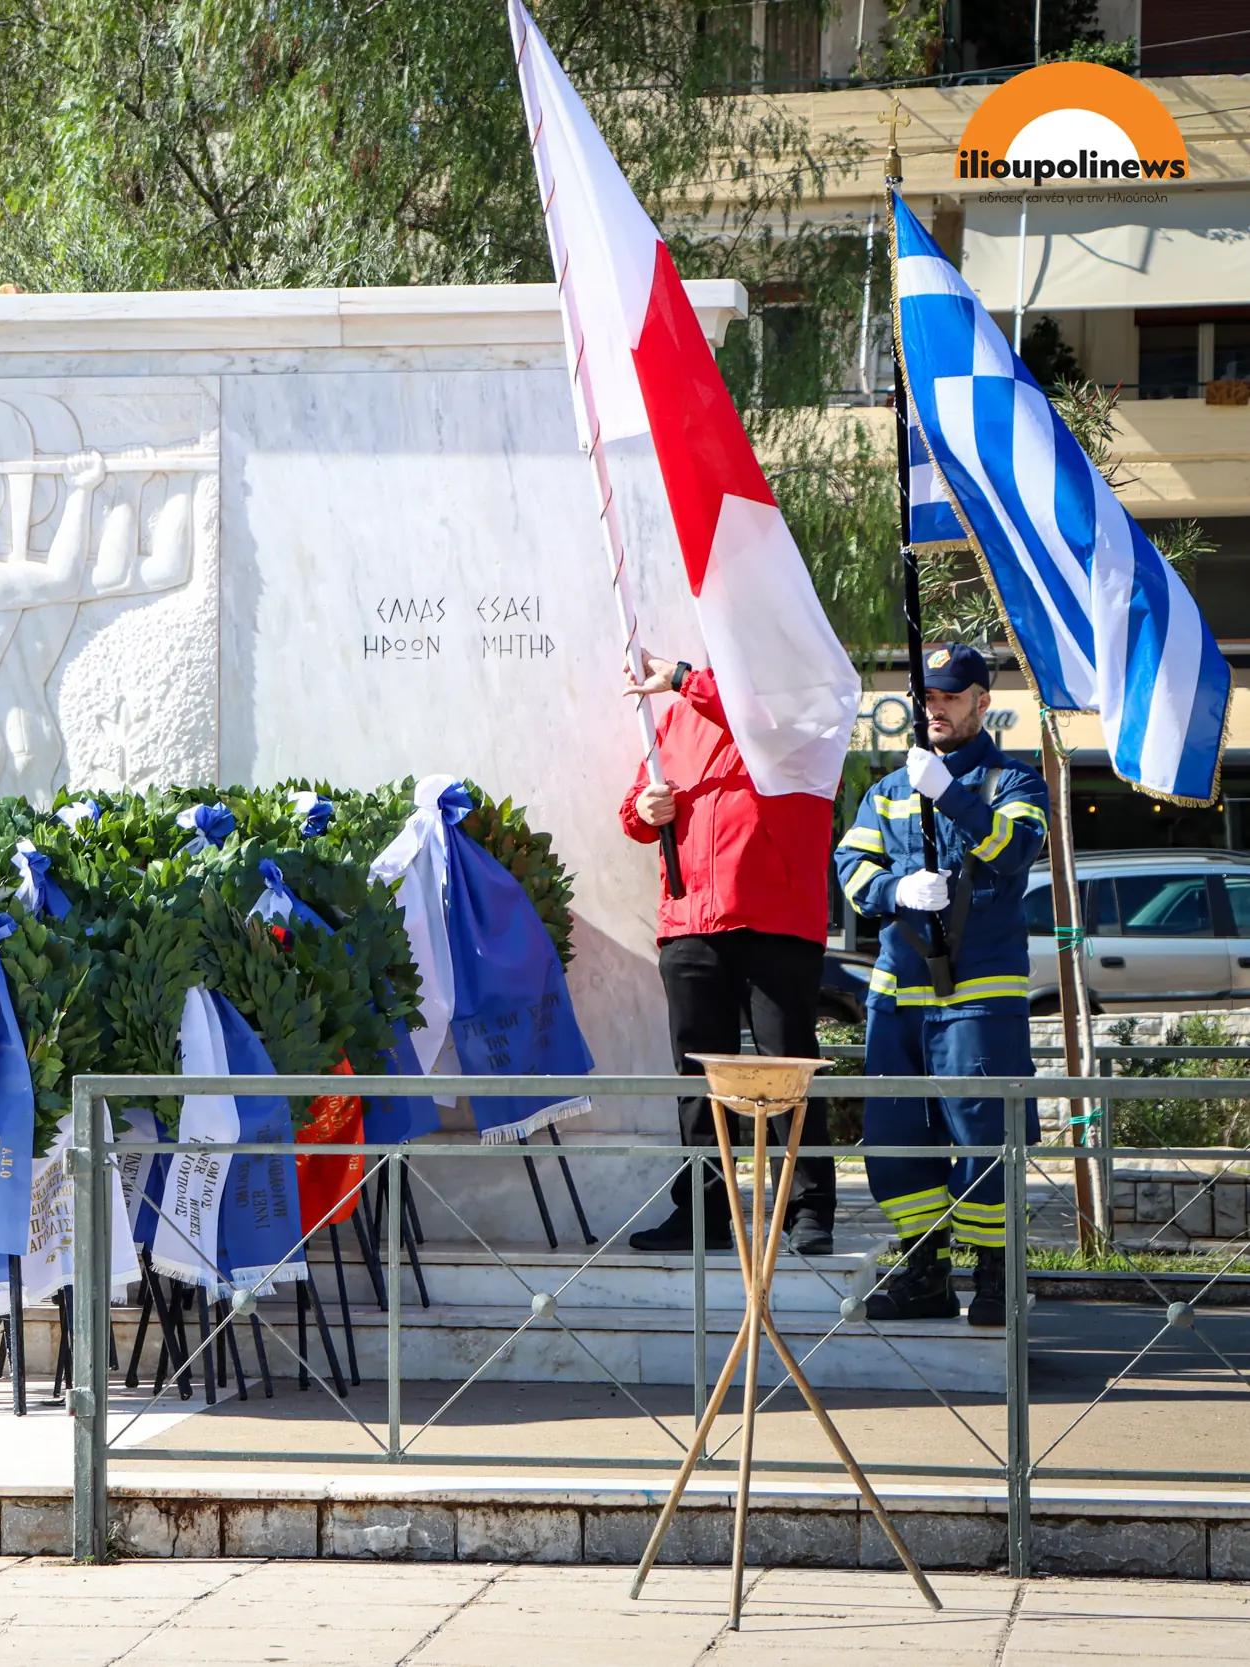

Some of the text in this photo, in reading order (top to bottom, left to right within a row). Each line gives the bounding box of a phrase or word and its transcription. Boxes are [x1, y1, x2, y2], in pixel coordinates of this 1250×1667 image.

[482, 634, 556, 660] ΜΗΤΗΡ
[174, 1136, 200, 1218] ΗΙΟΥΠΟΛΗΣ
[189, 1135, 215, 1238] INER WHEEL
[201, 1161, 220, 1211] ΟΜΙΛΟΣ
[252, 1190, 271, 1230] INNER
